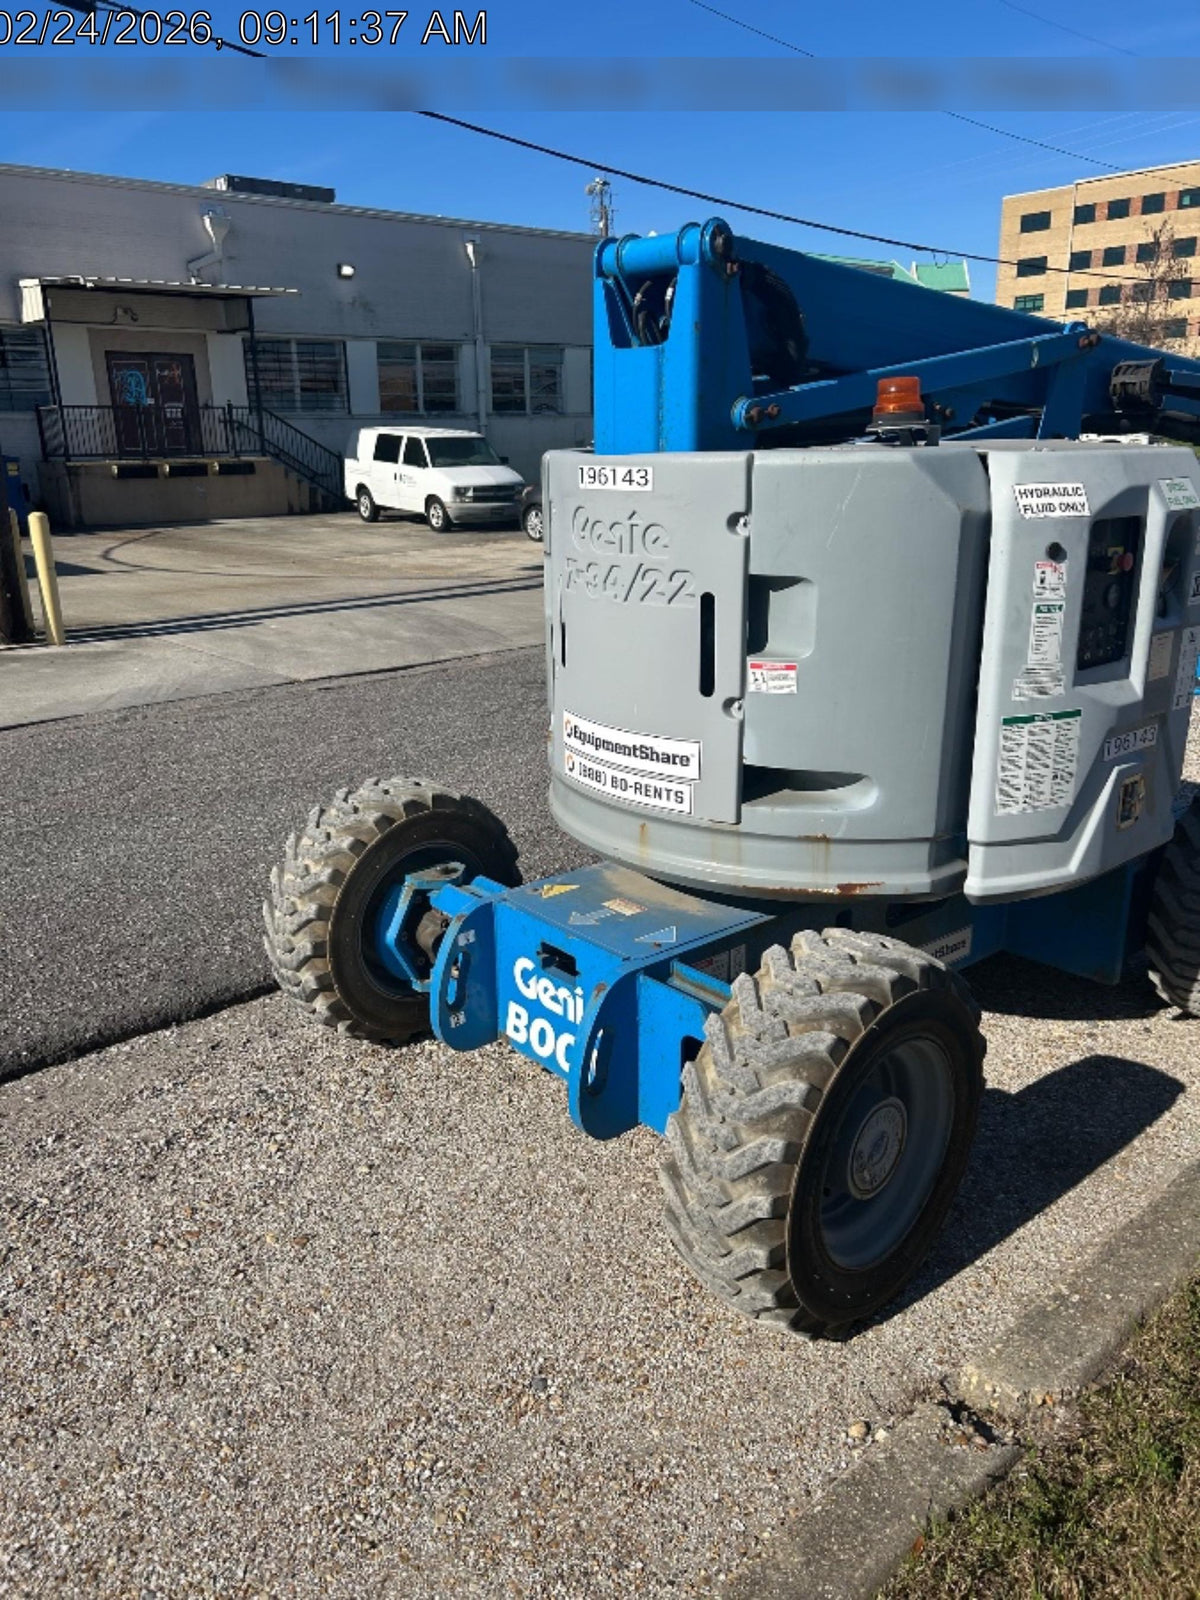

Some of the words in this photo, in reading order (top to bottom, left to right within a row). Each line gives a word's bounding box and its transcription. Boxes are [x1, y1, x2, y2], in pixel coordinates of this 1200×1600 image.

[578, 466, 650, 487] 196143
[1018, 486, 1083, 499] HYDRAULIC
[1022, 502, 1057, 514] FLUID
[1059, 502, 1086, 513] ONLY
[573, 724, 691, 768] EquipmentShare
[1105, 726, 1157, 757] 196143
[513, 956, 584, 1025] Geni
